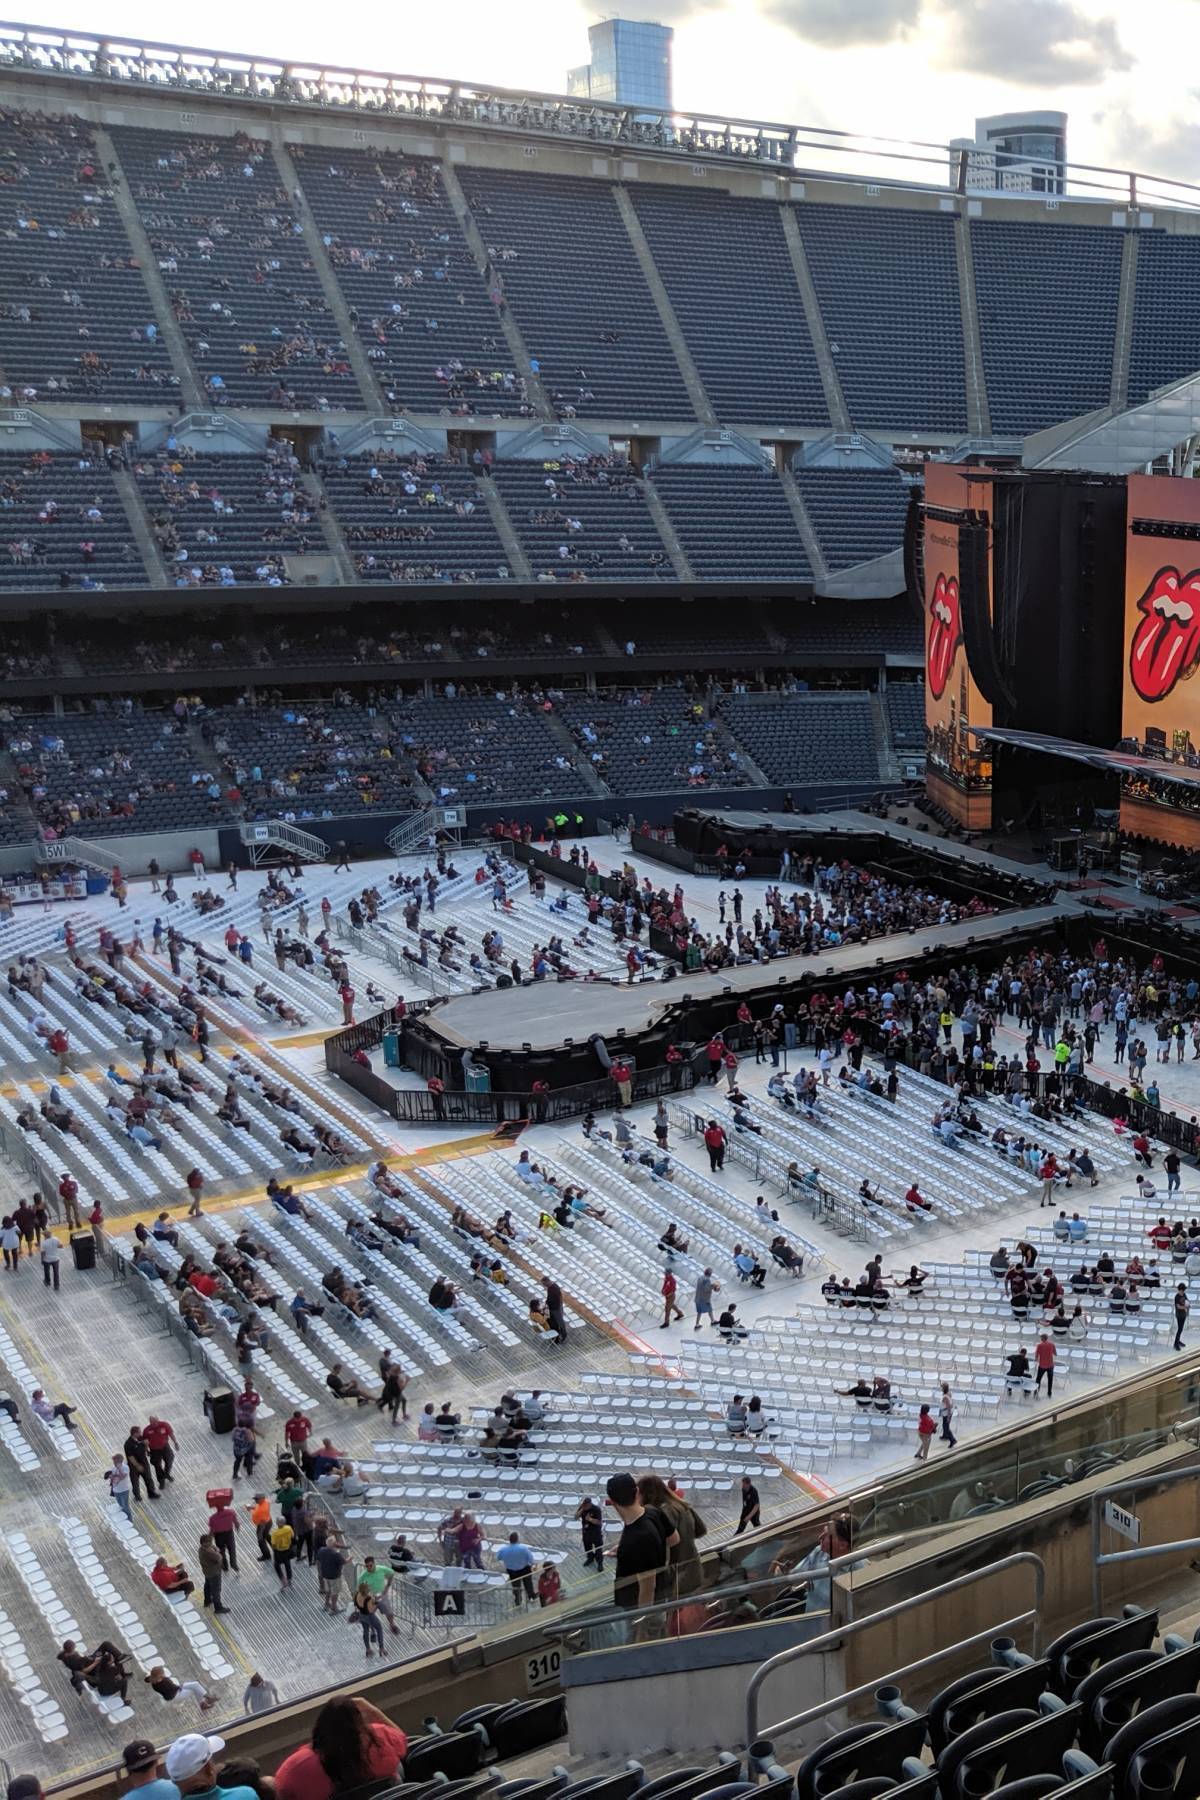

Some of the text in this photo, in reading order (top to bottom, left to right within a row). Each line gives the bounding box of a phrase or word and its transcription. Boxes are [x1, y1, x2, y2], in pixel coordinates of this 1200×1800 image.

[47, 844, 64, 858] 5W
[1112, 1508, 1131, 1528] 310
[442, 1594, 457, 1611] A
[528, 1651, 560, 1680] 310
